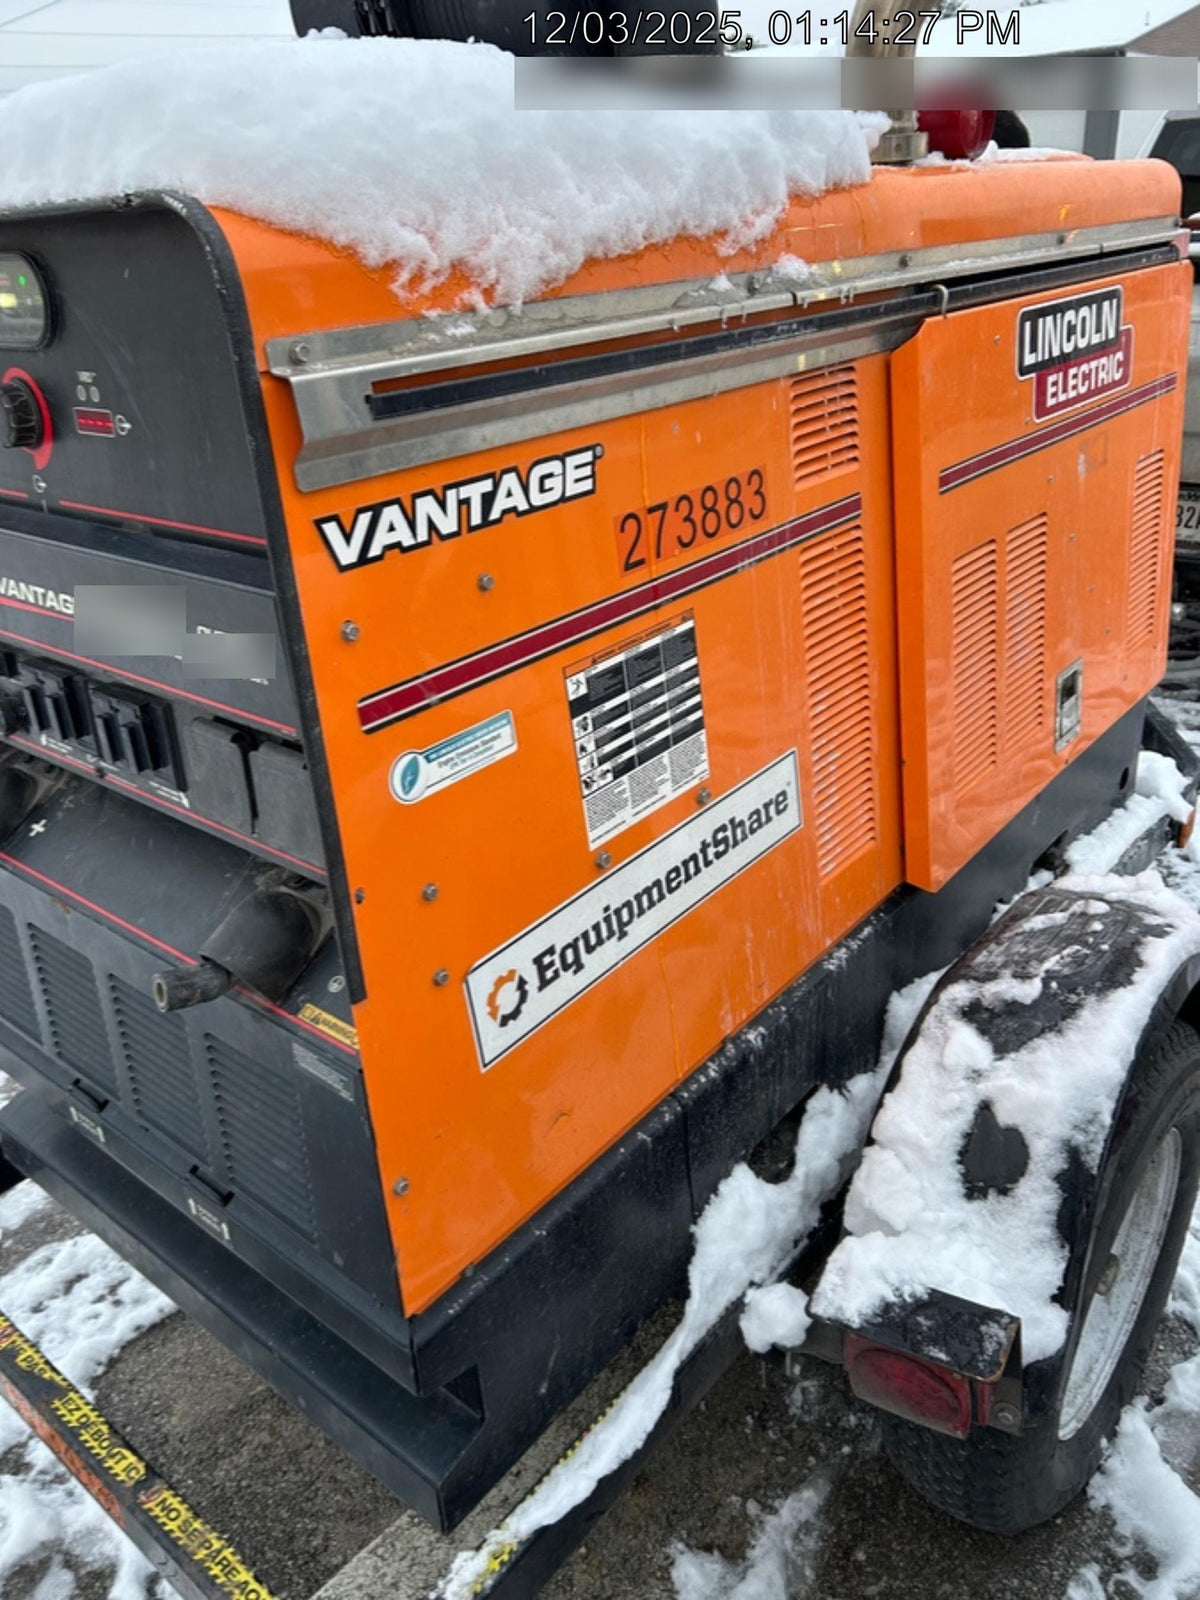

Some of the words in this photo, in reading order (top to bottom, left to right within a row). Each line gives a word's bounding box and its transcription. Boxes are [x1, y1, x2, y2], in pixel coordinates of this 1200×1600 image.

[1023, 298, 1118, 366] LINCOLN
[1045, 352, 1125, 408] ELECTRIC
[619, 468, 768, 573] 273883
[0, 577, 75, 615] VANTAG
[533, 788, 790, 992] EquipmentShare
[155, 1497, 182, 1522] NO
[197, 1540, 241, 1583] PARE
